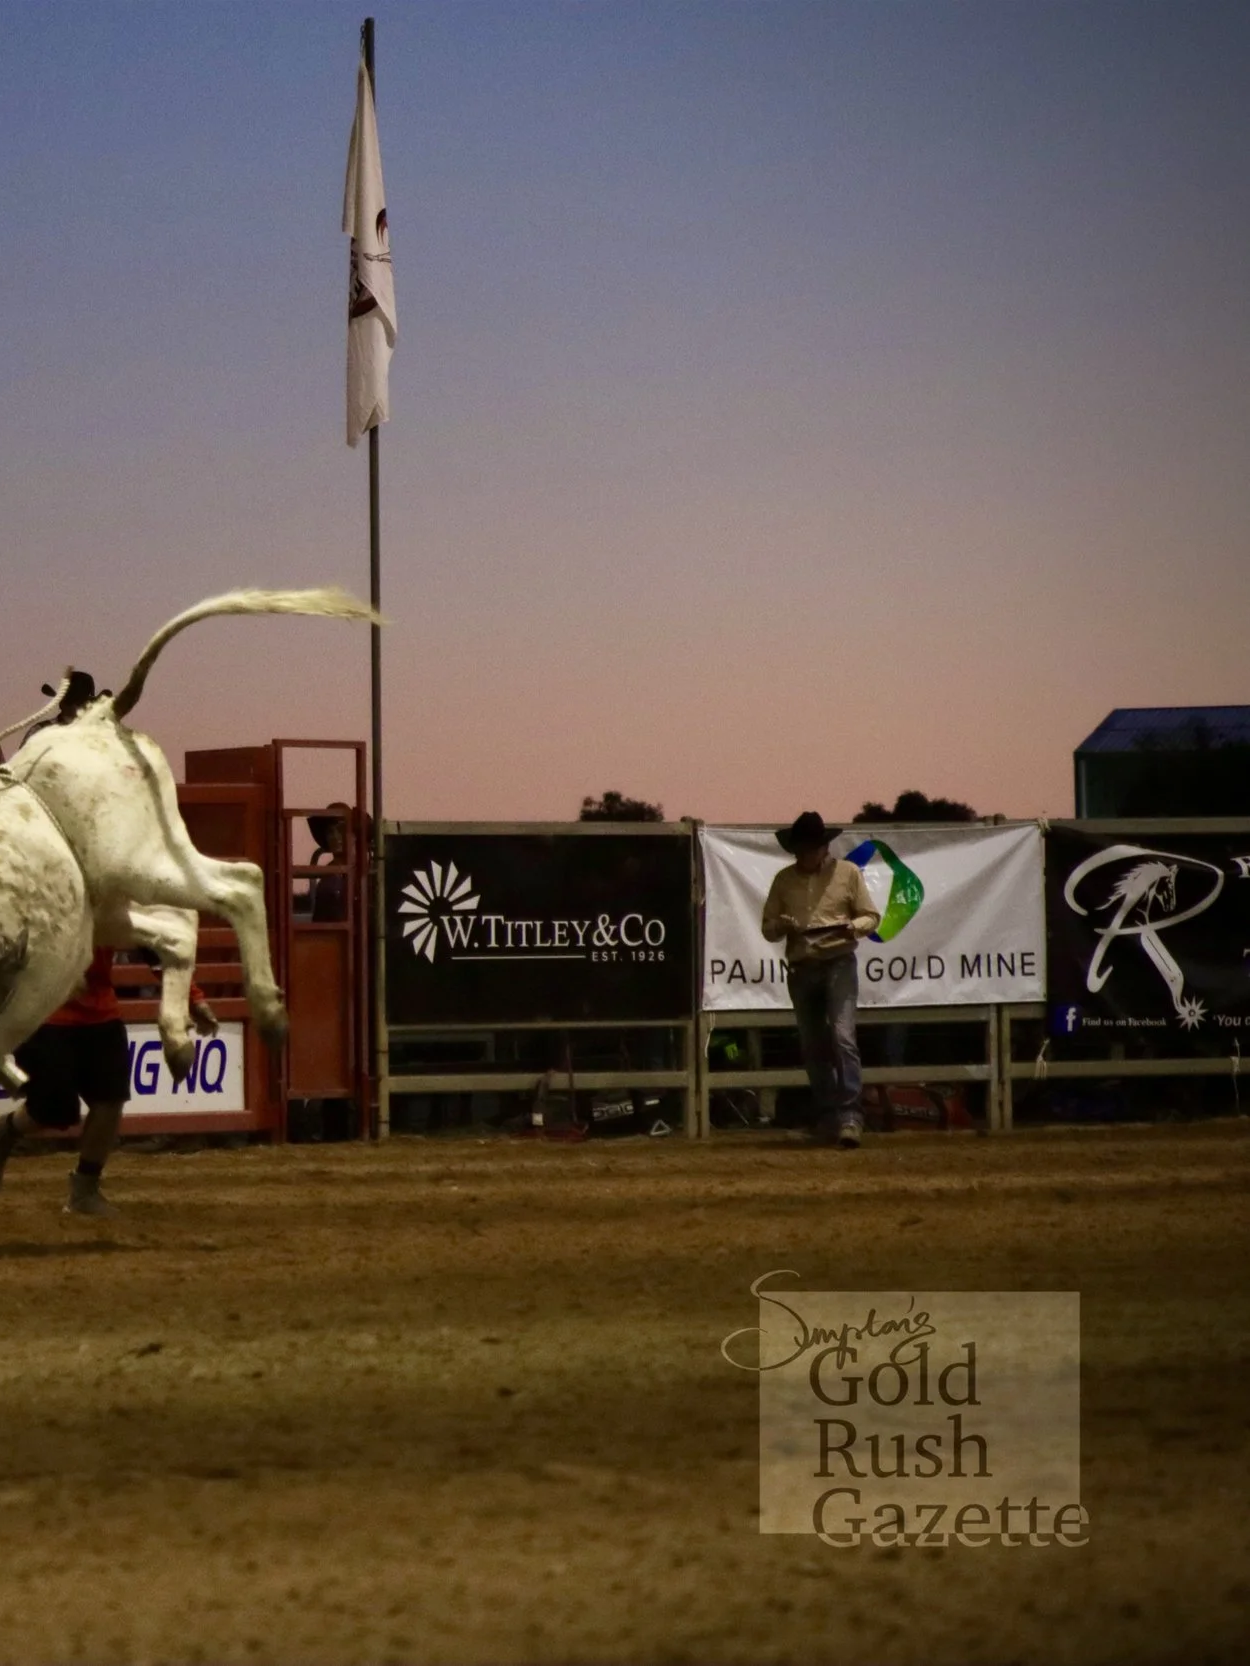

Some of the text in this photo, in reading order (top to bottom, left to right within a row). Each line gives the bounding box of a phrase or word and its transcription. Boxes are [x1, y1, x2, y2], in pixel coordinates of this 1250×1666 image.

[592, 950, 665, 962] EST. 1926
[710, 952, 1037, 984] PAJIN GOLD MINE
[1081, 1016, 1102, 1027] Find
